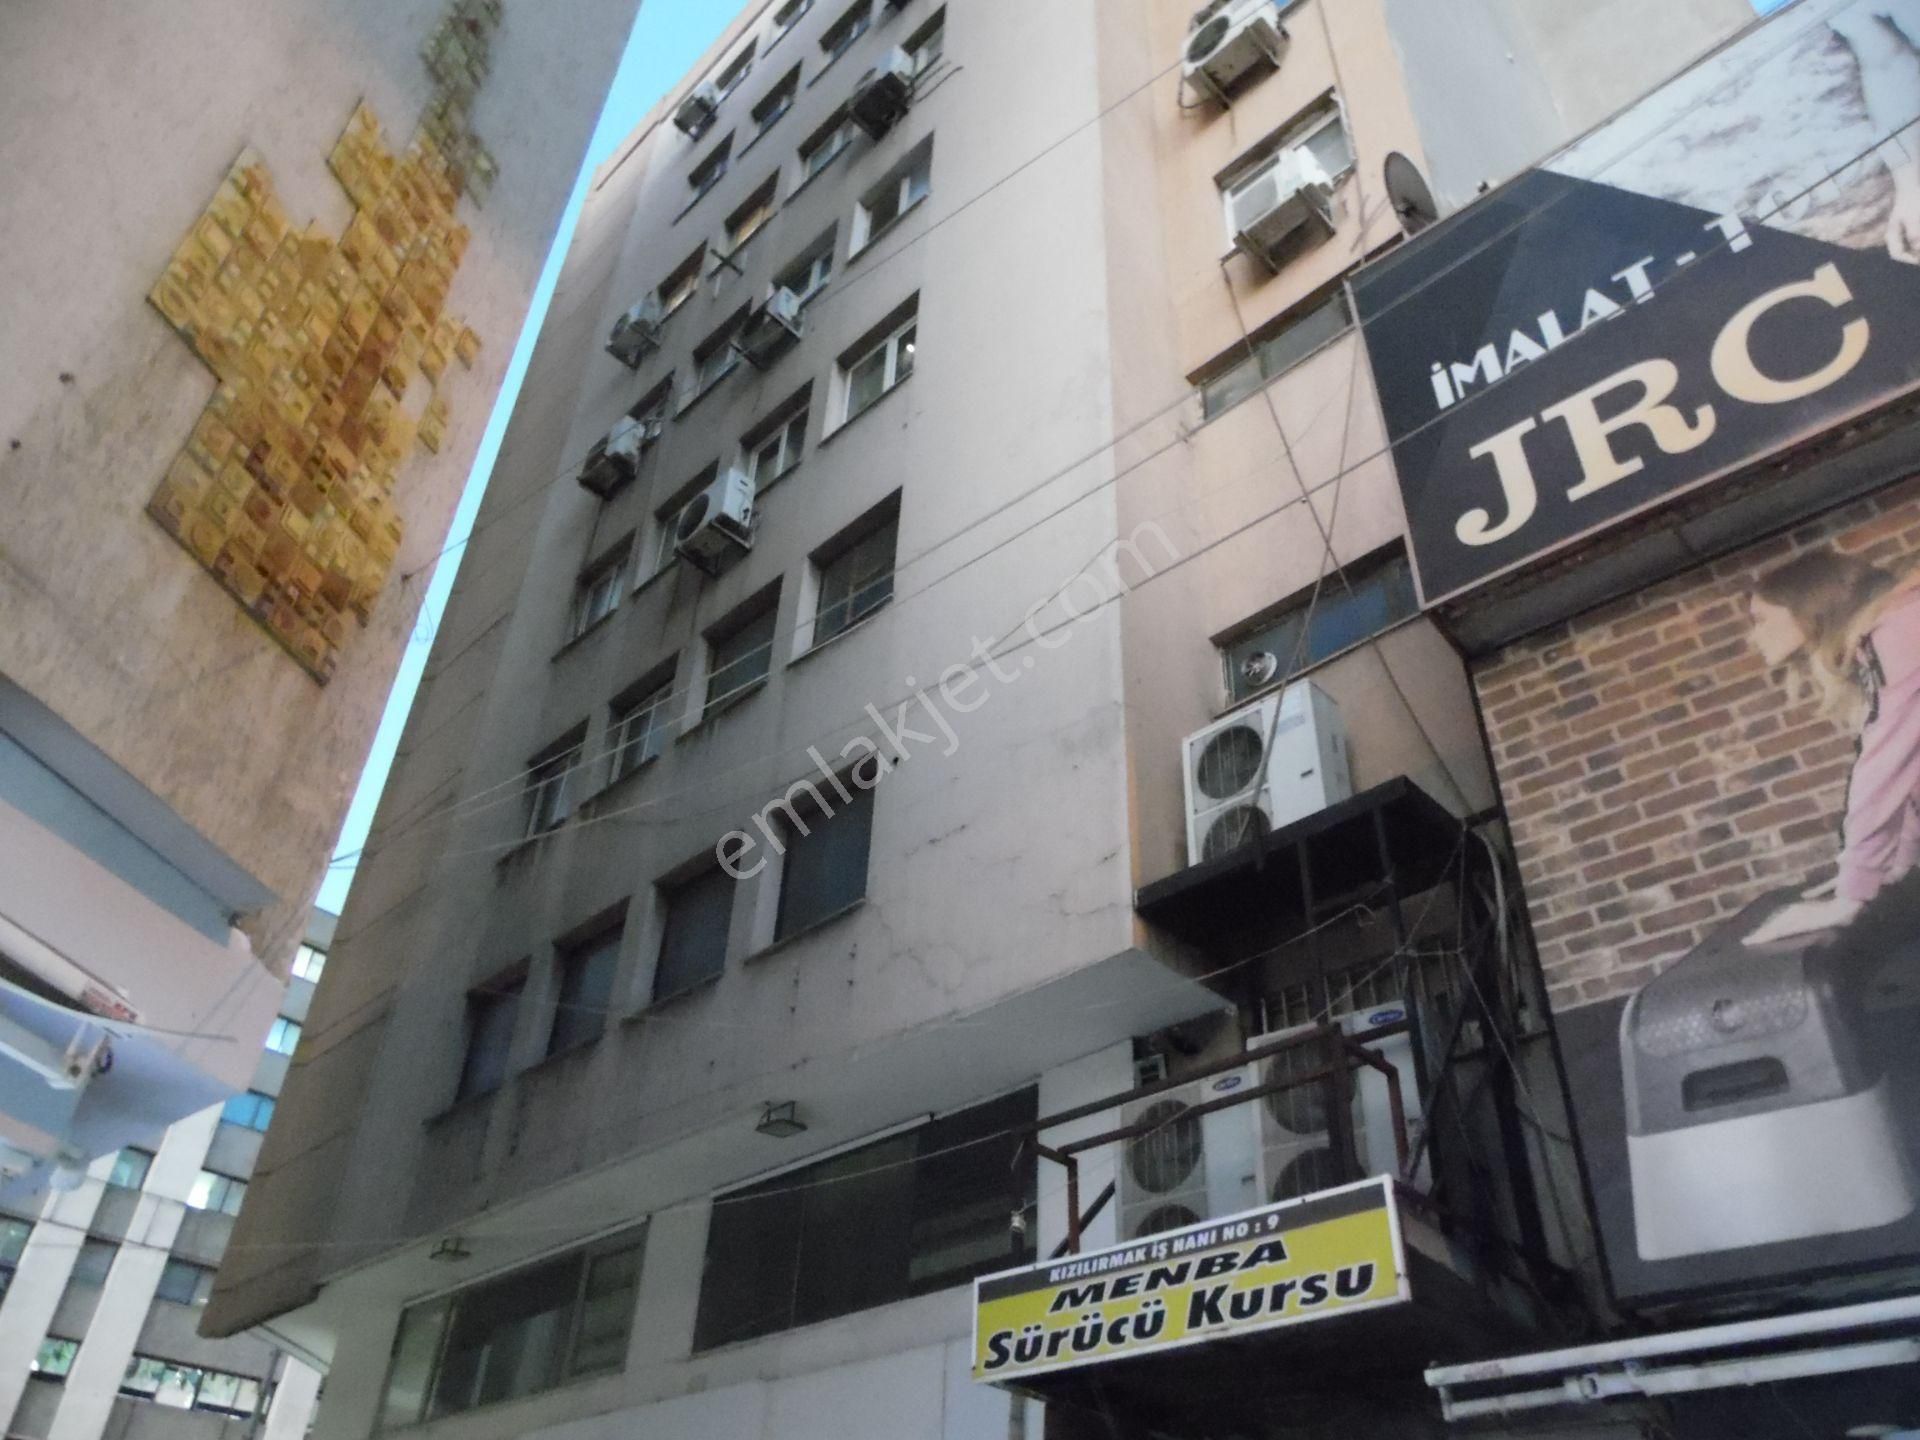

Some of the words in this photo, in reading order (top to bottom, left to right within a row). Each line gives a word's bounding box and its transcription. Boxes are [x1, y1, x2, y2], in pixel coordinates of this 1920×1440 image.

[1430, 255, 1656, 410] İMALAT
[1454, 261, 1870, 547] JRC
[1049, 1247, 1148, 1283] KIZILIRMAK
[1172, 1230, 1217, 1254] HANI
[1222, 1221, 1248, 1242] NO
[1267, 1213, 1280, 1230] 9
[1050, 1239, 1288, 1313] MENBA
[983, 1300, 1168, 1370] Sürücü
[1186, 1262, 1375, 1332] Kursu
